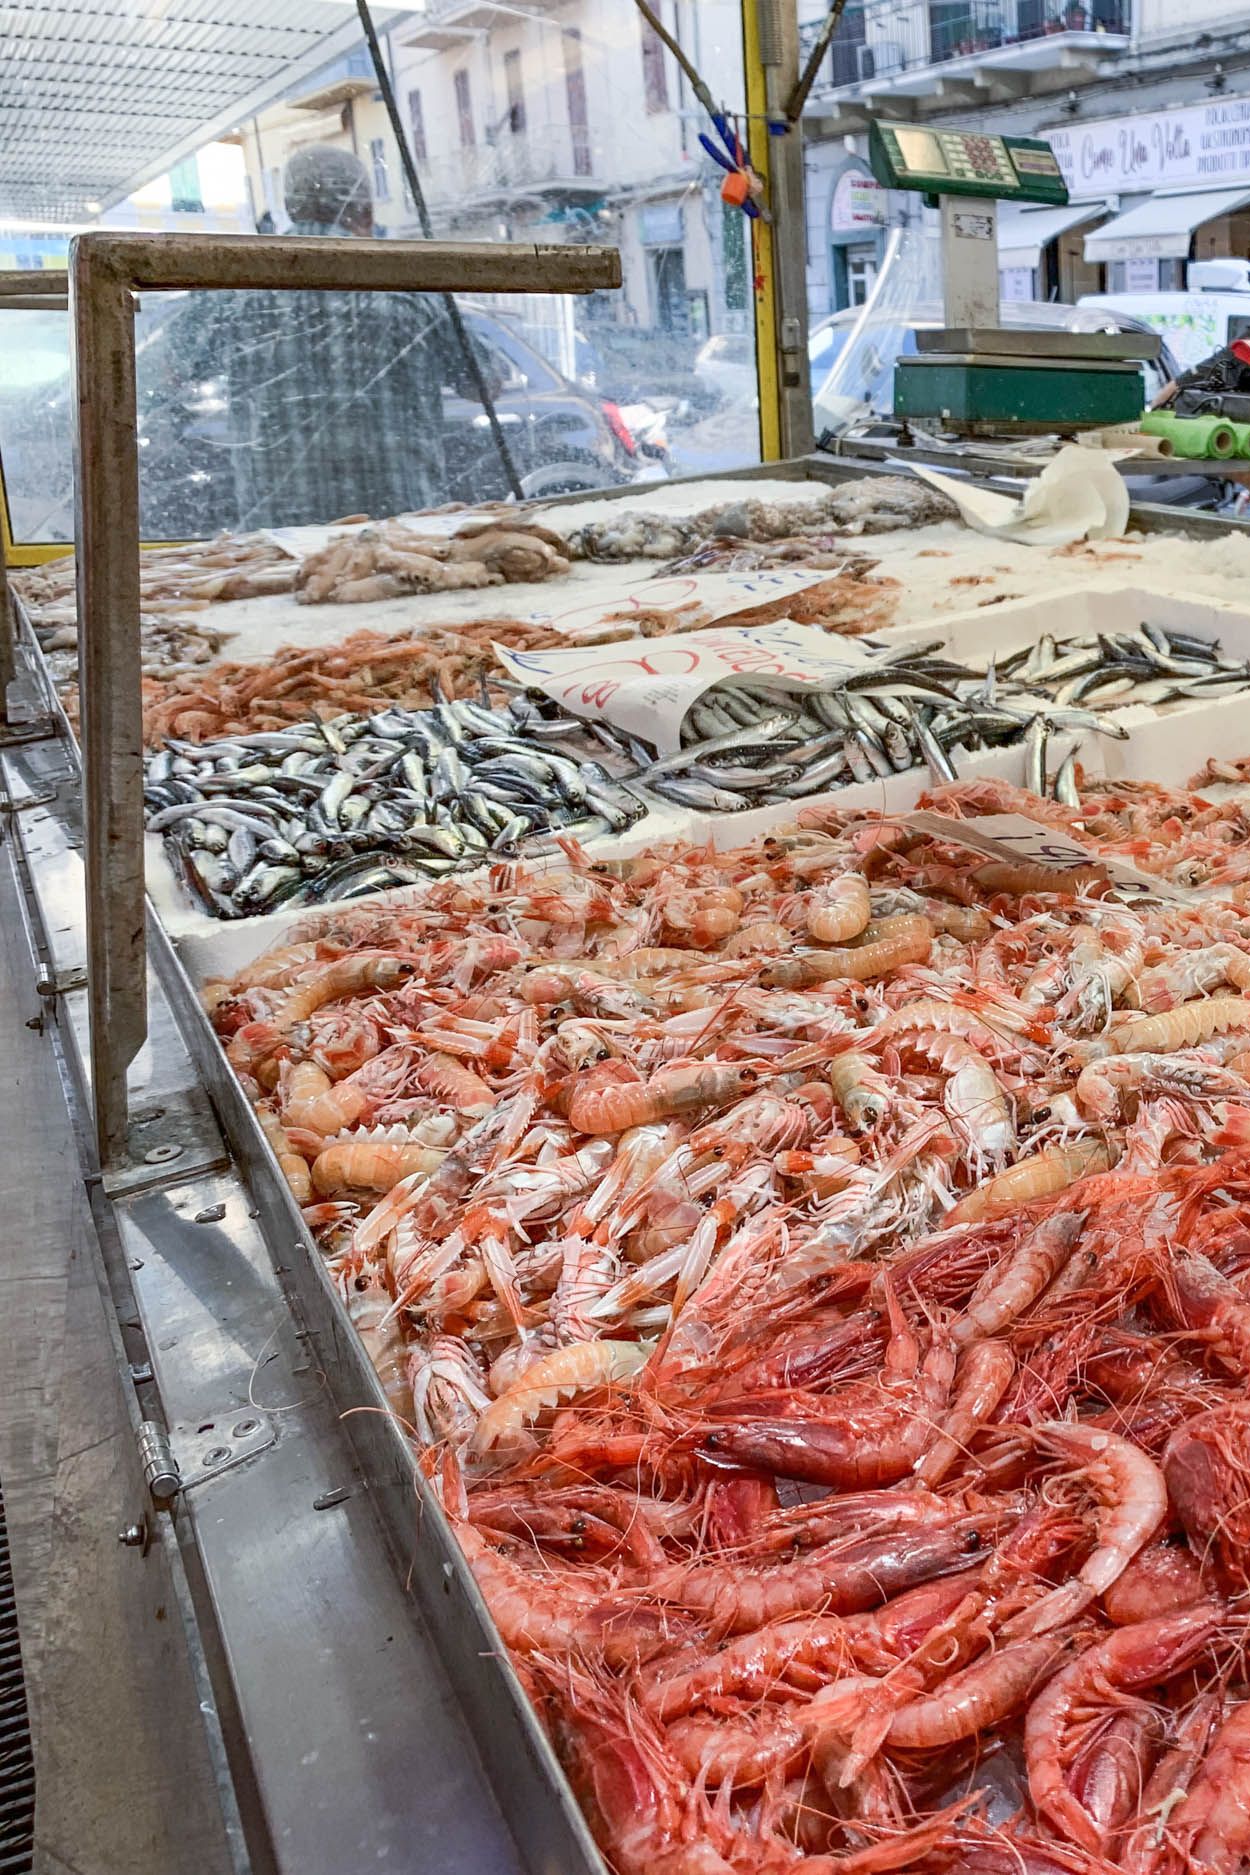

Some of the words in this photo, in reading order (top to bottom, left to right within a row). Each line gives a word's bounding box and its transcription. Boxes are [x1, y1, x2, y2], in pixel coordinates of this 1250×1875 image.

[1080, 133, 1114, 179] Come
[1119, 128, 1148, 176] Una
[1152, 119, 1191, 172] Volta
